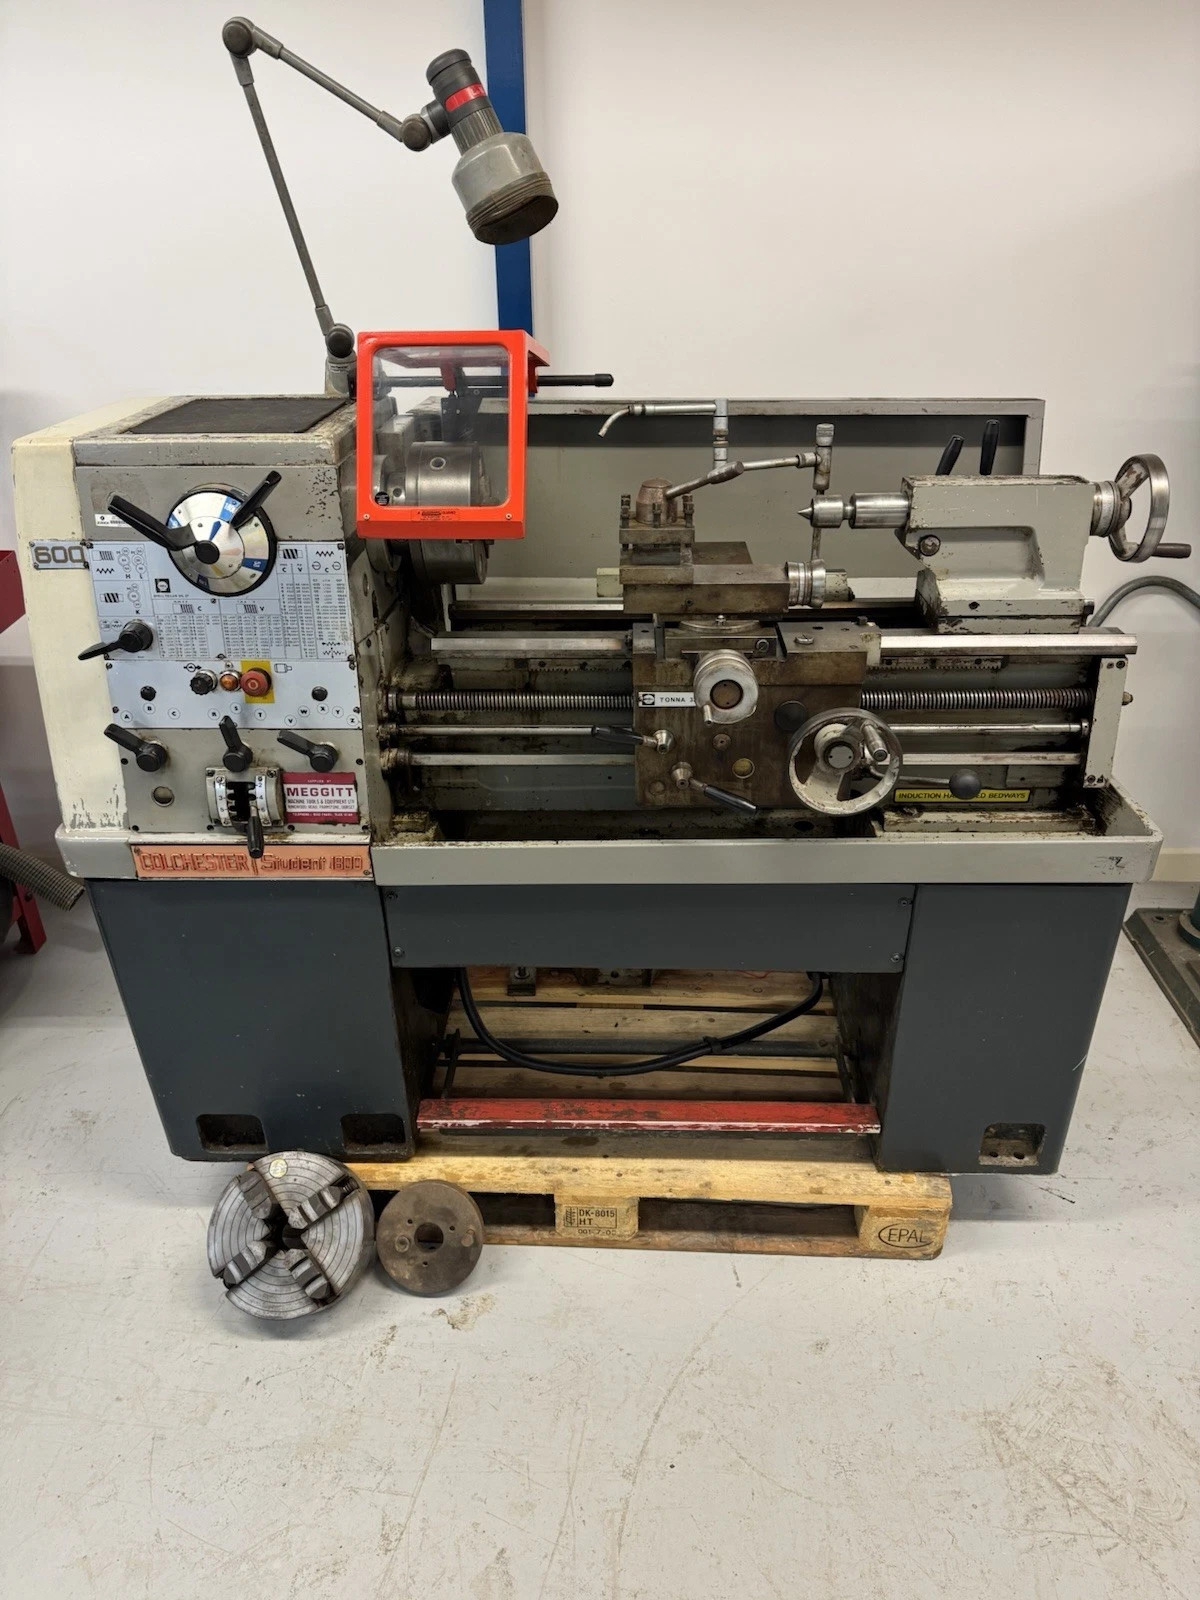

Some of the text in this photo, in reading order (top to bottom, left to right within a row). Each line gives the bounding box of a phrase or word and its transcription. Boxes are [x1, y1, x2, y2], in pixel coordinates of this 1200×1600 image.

[34, 546, 86, 563] 600
[286, 787, 353, 796] MEGGITT
[140, 853, 363, 871] COLCHESTER Student 1800
[579, 1208, 615, 1217] DK-8015
[887, 1228, 928, 1243] EPAL
